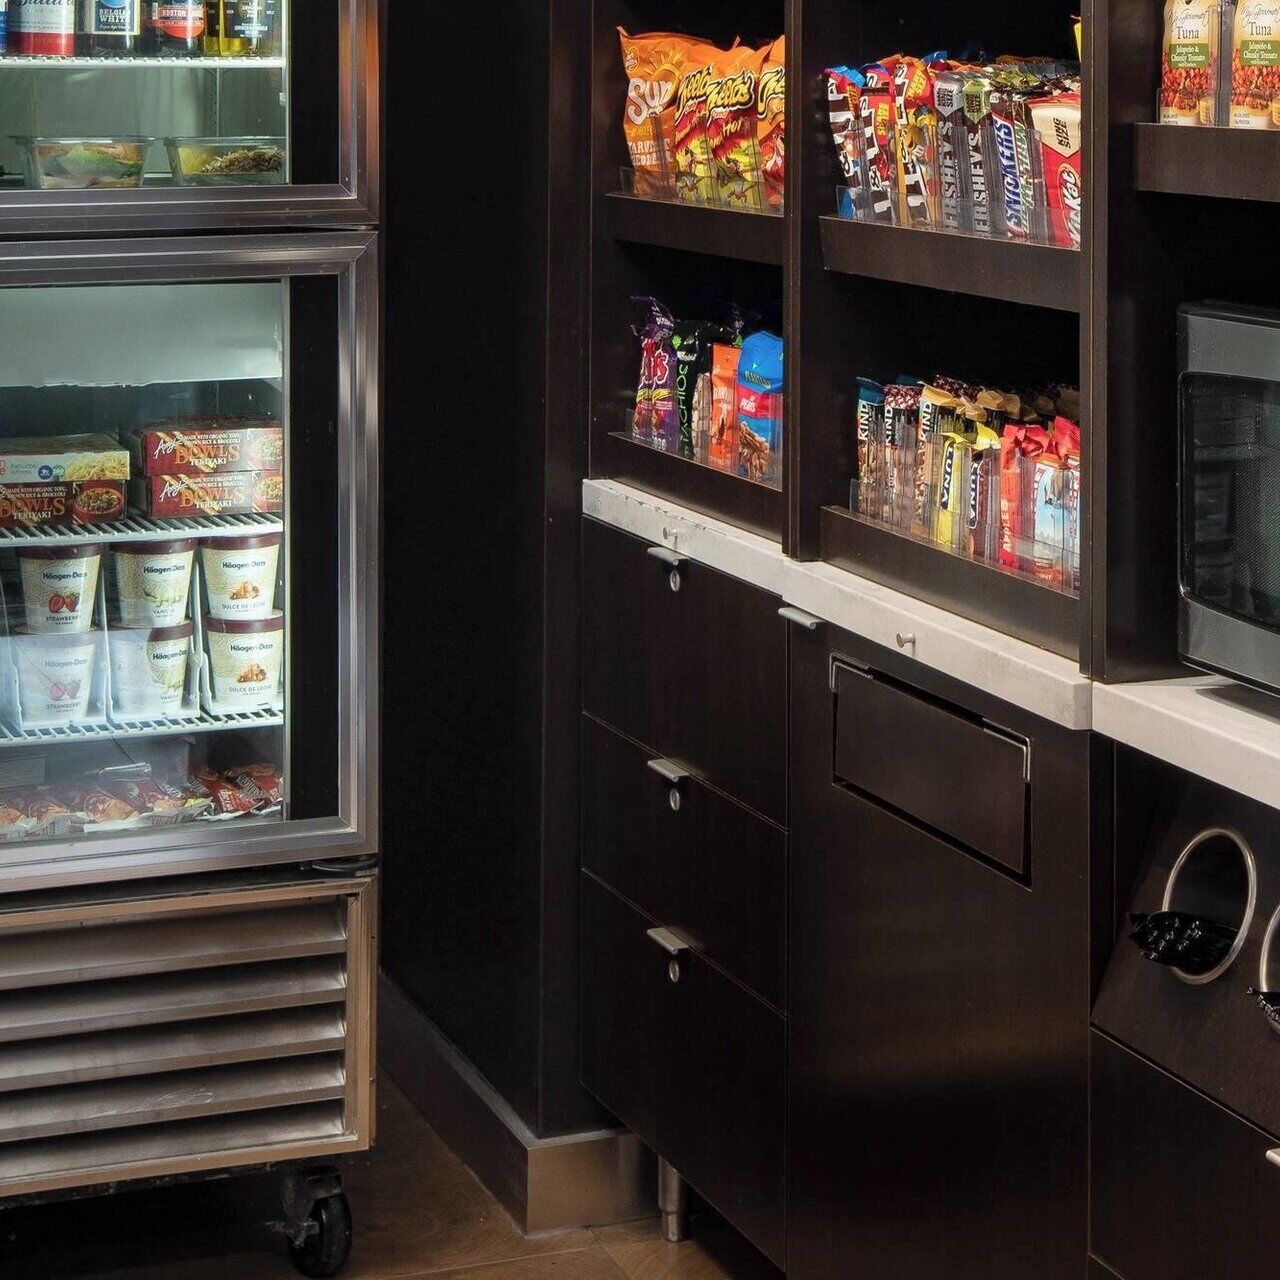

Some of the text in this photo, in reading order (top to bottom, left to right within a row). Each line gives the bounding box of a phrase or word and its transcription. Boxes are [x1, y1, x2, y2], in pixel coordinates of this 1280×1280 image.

[1177, 26, 1199, 40] Tuna
[1249, 22, 1272, 36] Tuna
[1188, 54, 1205, 62] Tomato
[1053, 117, 1065, 147] KING
[1062, 120, 1072, 149] SIZE
[993, 117, 1023, 228] SNICKERS
[858, 402, 870, 440] KIND
[885, 404, 894, 446] KIND
[919, 402, 932, 441] KIND
[175, 444, 240, 465] BOWLS
[190, 458, 227, 466] TERIYAKI
[941, 445, 954, 509] LUNA
[180, 487, 245, 508] BOWLS
[195, 500, 232, 509] TERIYAKI
[14, 511, 51, 520] TERIYAKI
